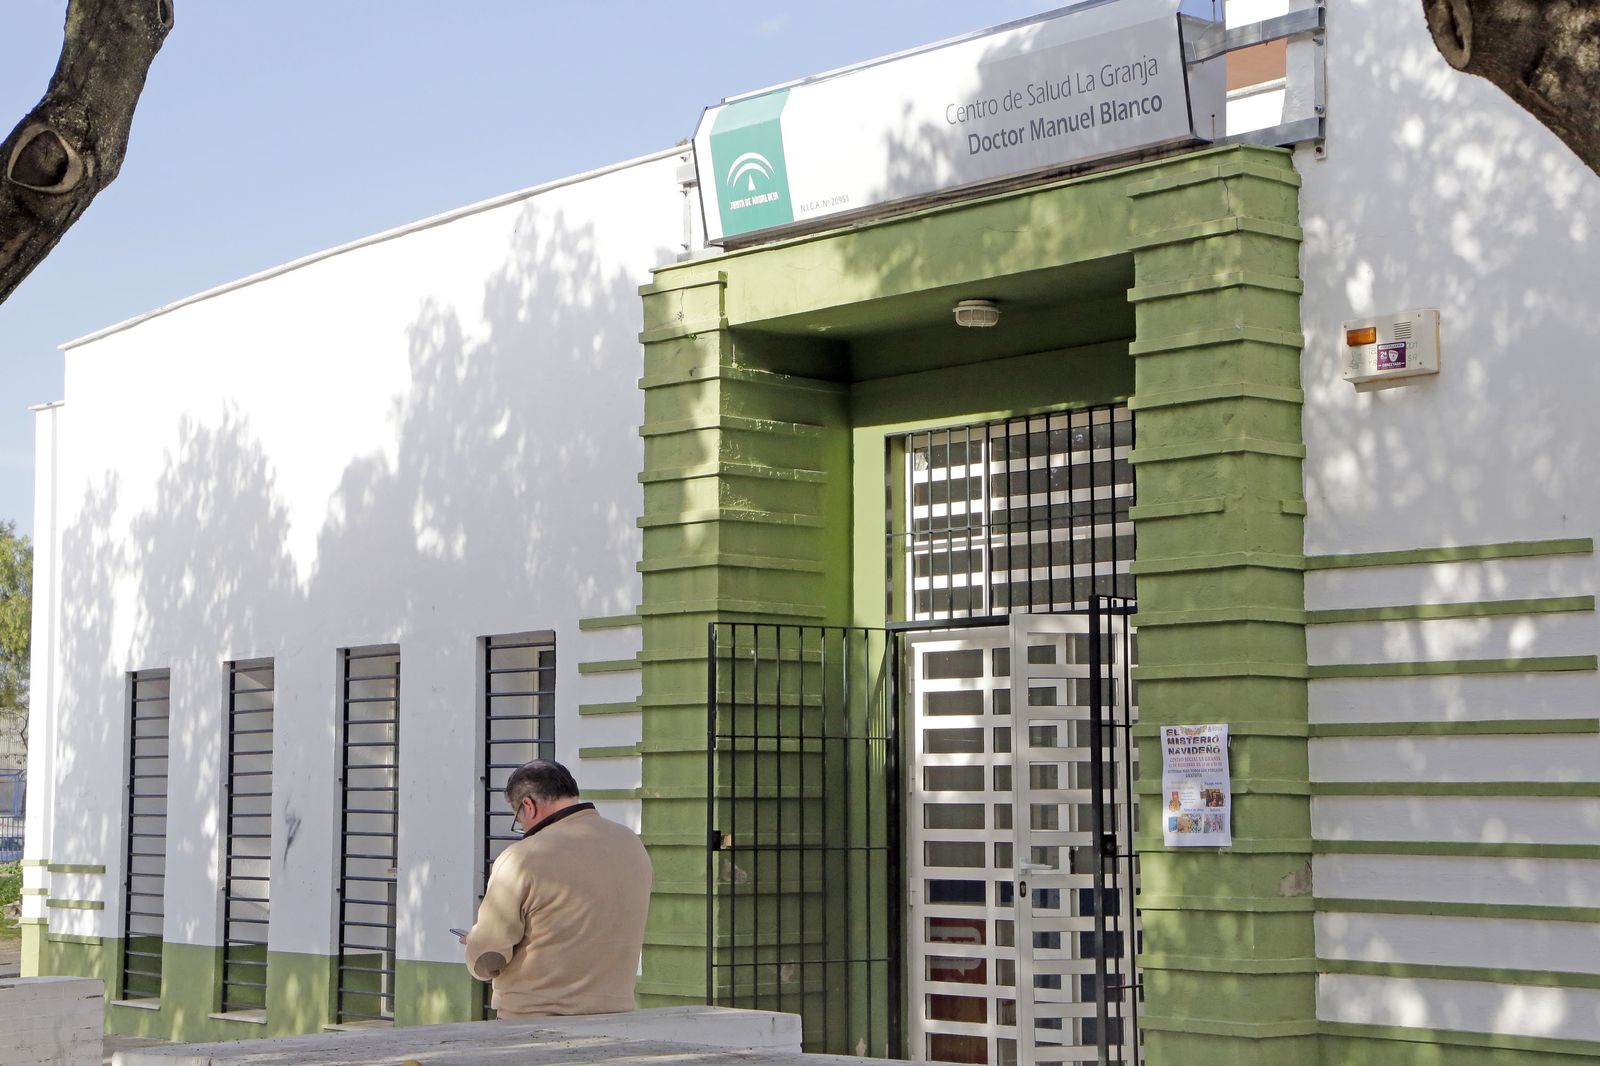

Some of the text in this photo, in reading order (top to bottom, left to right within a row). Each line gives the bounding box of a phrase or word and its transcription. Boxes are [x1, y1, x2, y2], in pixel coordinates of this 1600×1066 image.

[945, 55, 1159, 126] Centro de Salud La Granja
[967, 94, 1163, 155] Doctor Manuel Blanco
[1166, 728, 1180, 736] EL
[1167, 735, 1219, 745] MISTERIO
[1168, 745, 1221, 755] NAVIDEÑO
